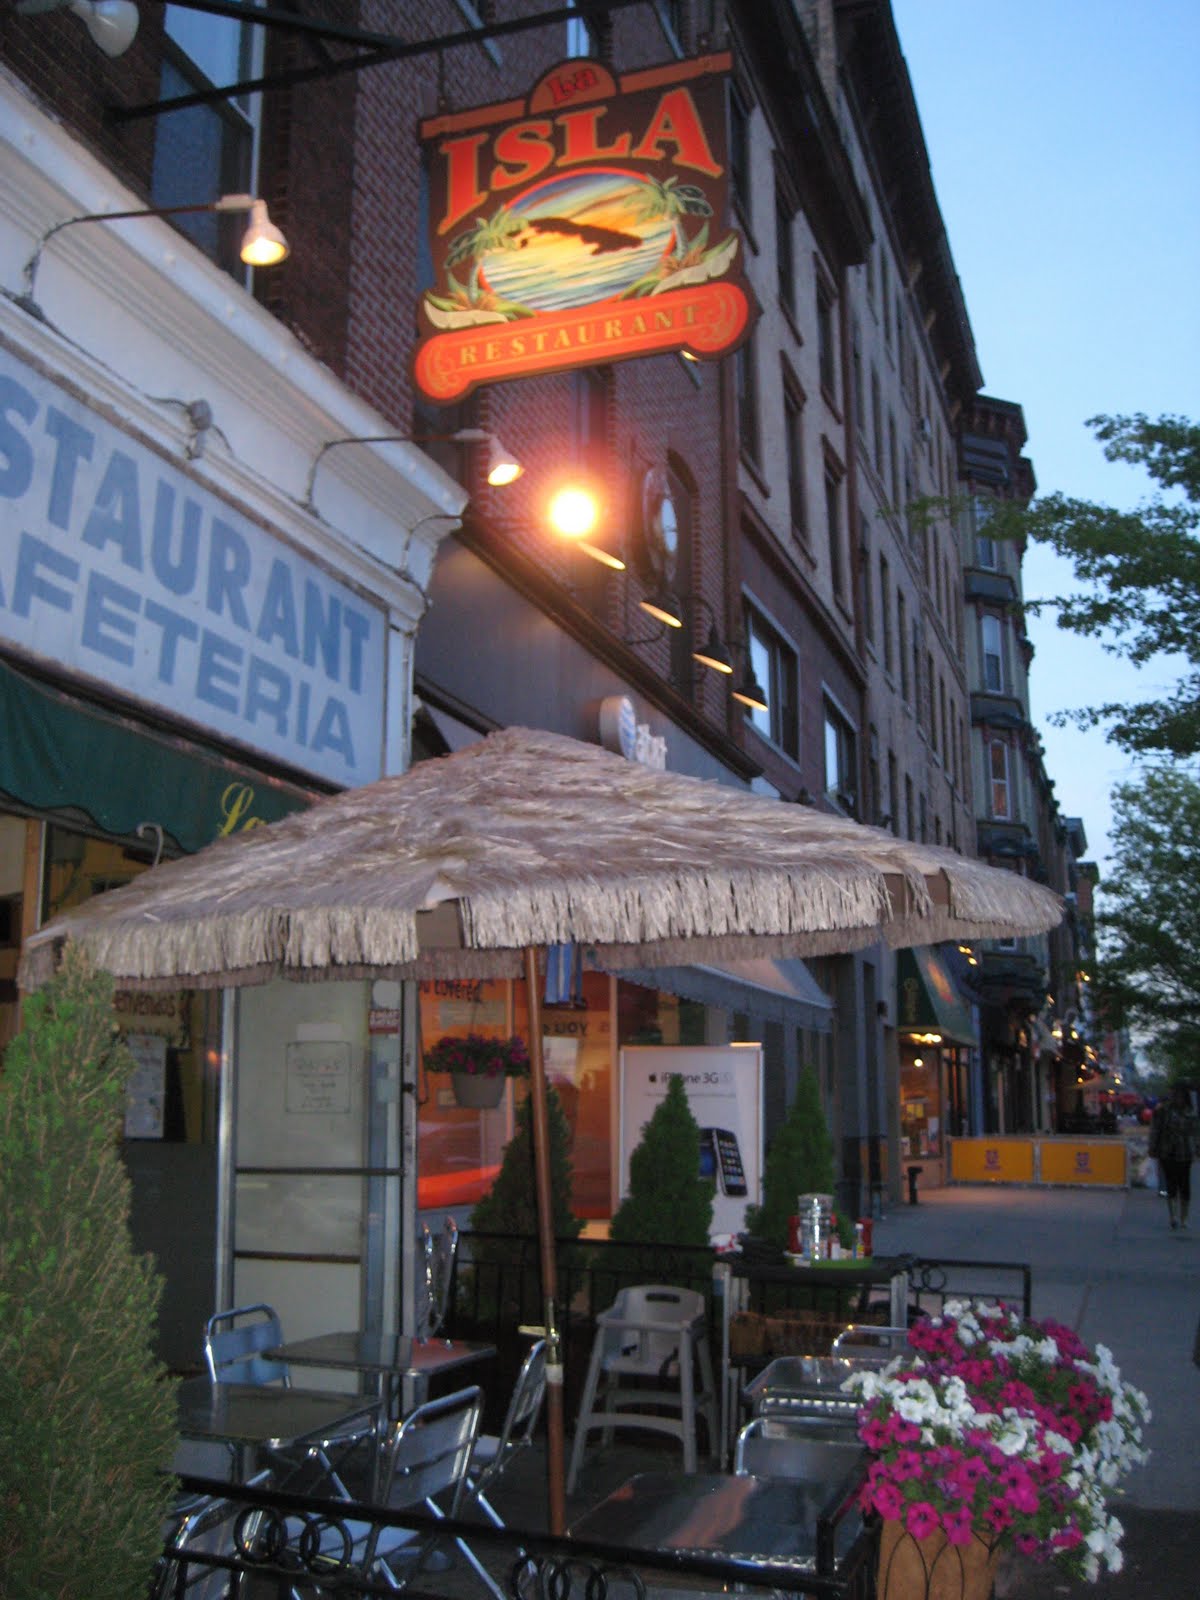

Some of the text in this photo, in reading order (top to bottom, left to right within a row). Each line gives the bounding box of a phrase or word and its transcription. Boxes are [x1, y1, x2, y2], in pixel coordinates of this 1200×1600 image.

[438, 87, 723, 235] ISLA
[459, 303, 701, 366] RESTAURANT
[0, 530, 356, 768] FETERIA
[660, 1072, 701, 1084] iPne
